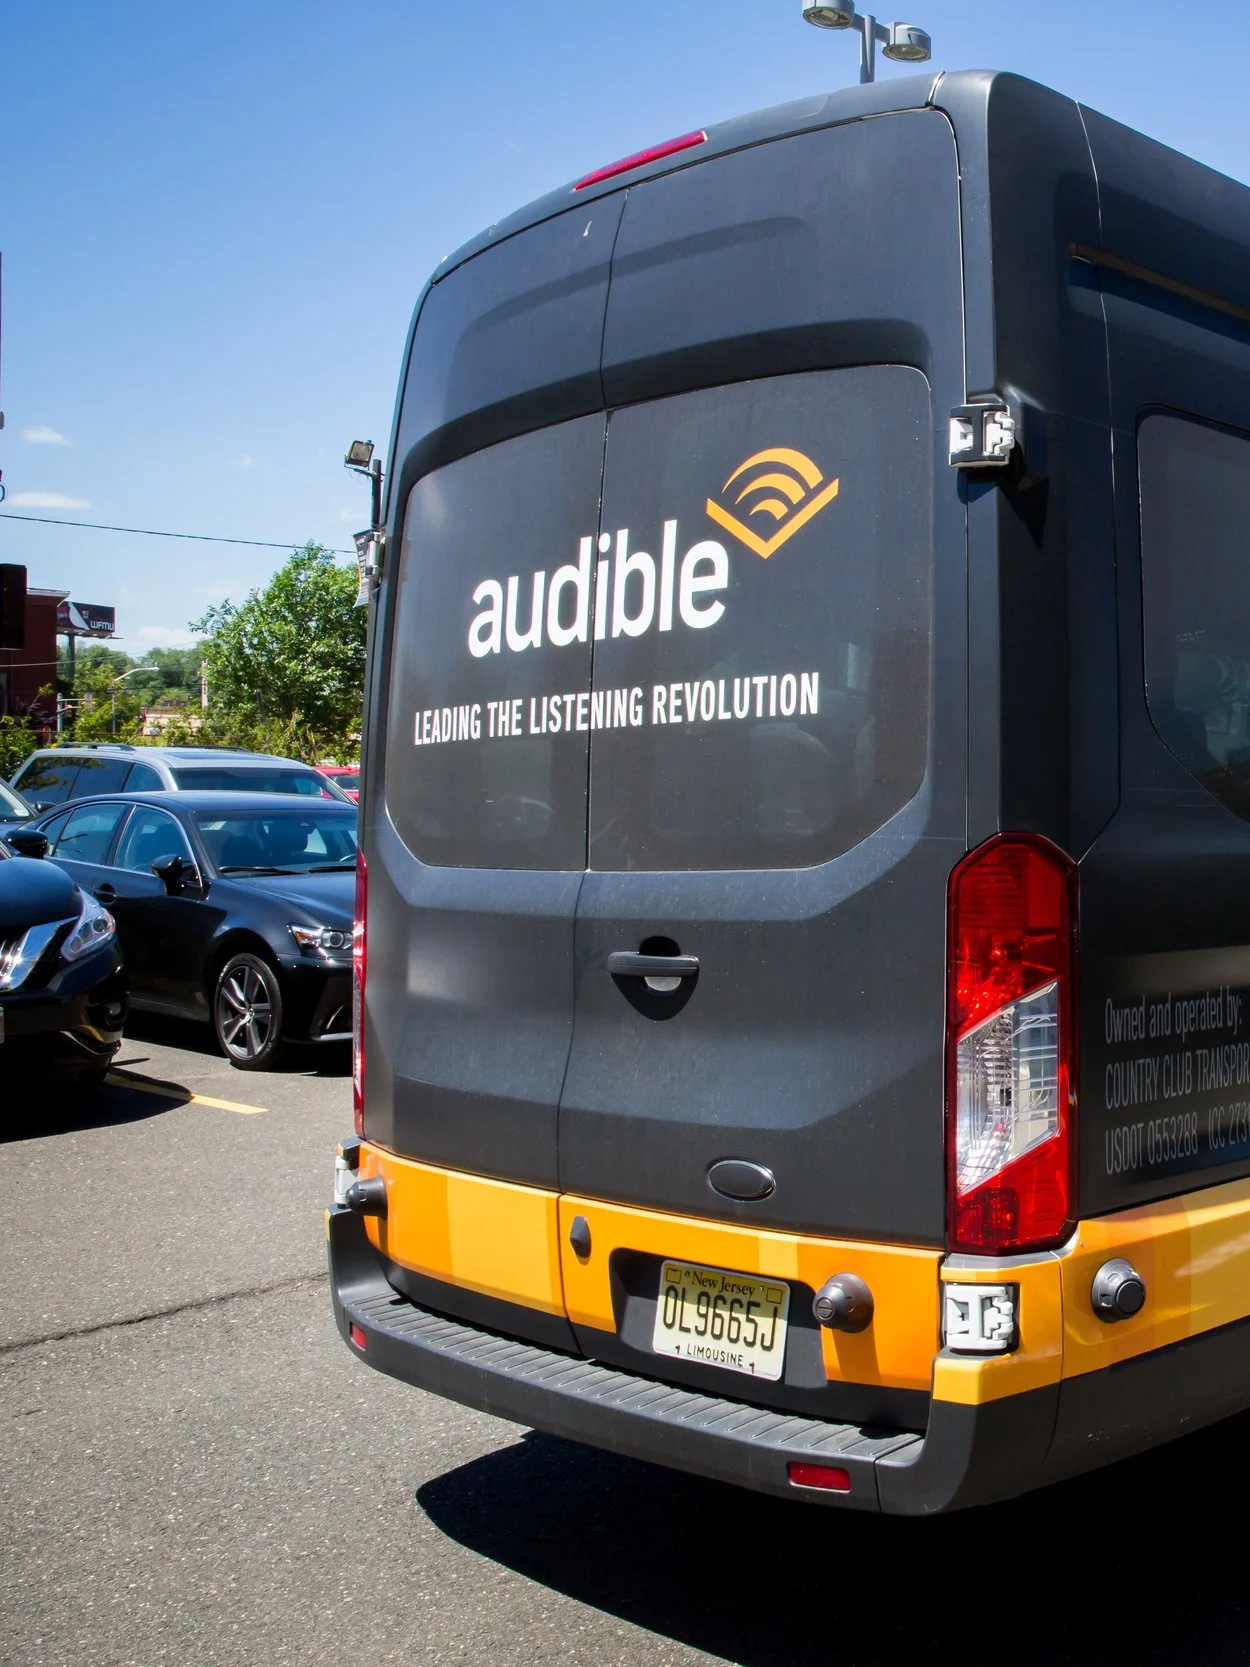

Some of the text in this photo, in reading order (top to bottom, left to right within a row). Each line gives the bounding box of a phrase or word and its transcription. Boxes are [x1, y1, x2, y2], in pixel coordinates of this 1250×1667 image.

[468, 519, 729, 658] audible
[414, 672, 820, 746] LEADING THE LISTENING REVOLUTION
[1105, 984, 1242, 1044] Owned and operated by:
[1105, 1057, 1159, 1110] COUNTRY
[1163, 1051, 1193, 1098] CLUB
[1105, 1123, 1144, 1175] USDOT
[1208, 1106, 1225, 1150] ICC
[691, 1270, 755, 1296] New Jersey
[663, 1285, 778, 1352] OL9665J
[687, 1343, 744, 1367] LIMOUSINE
